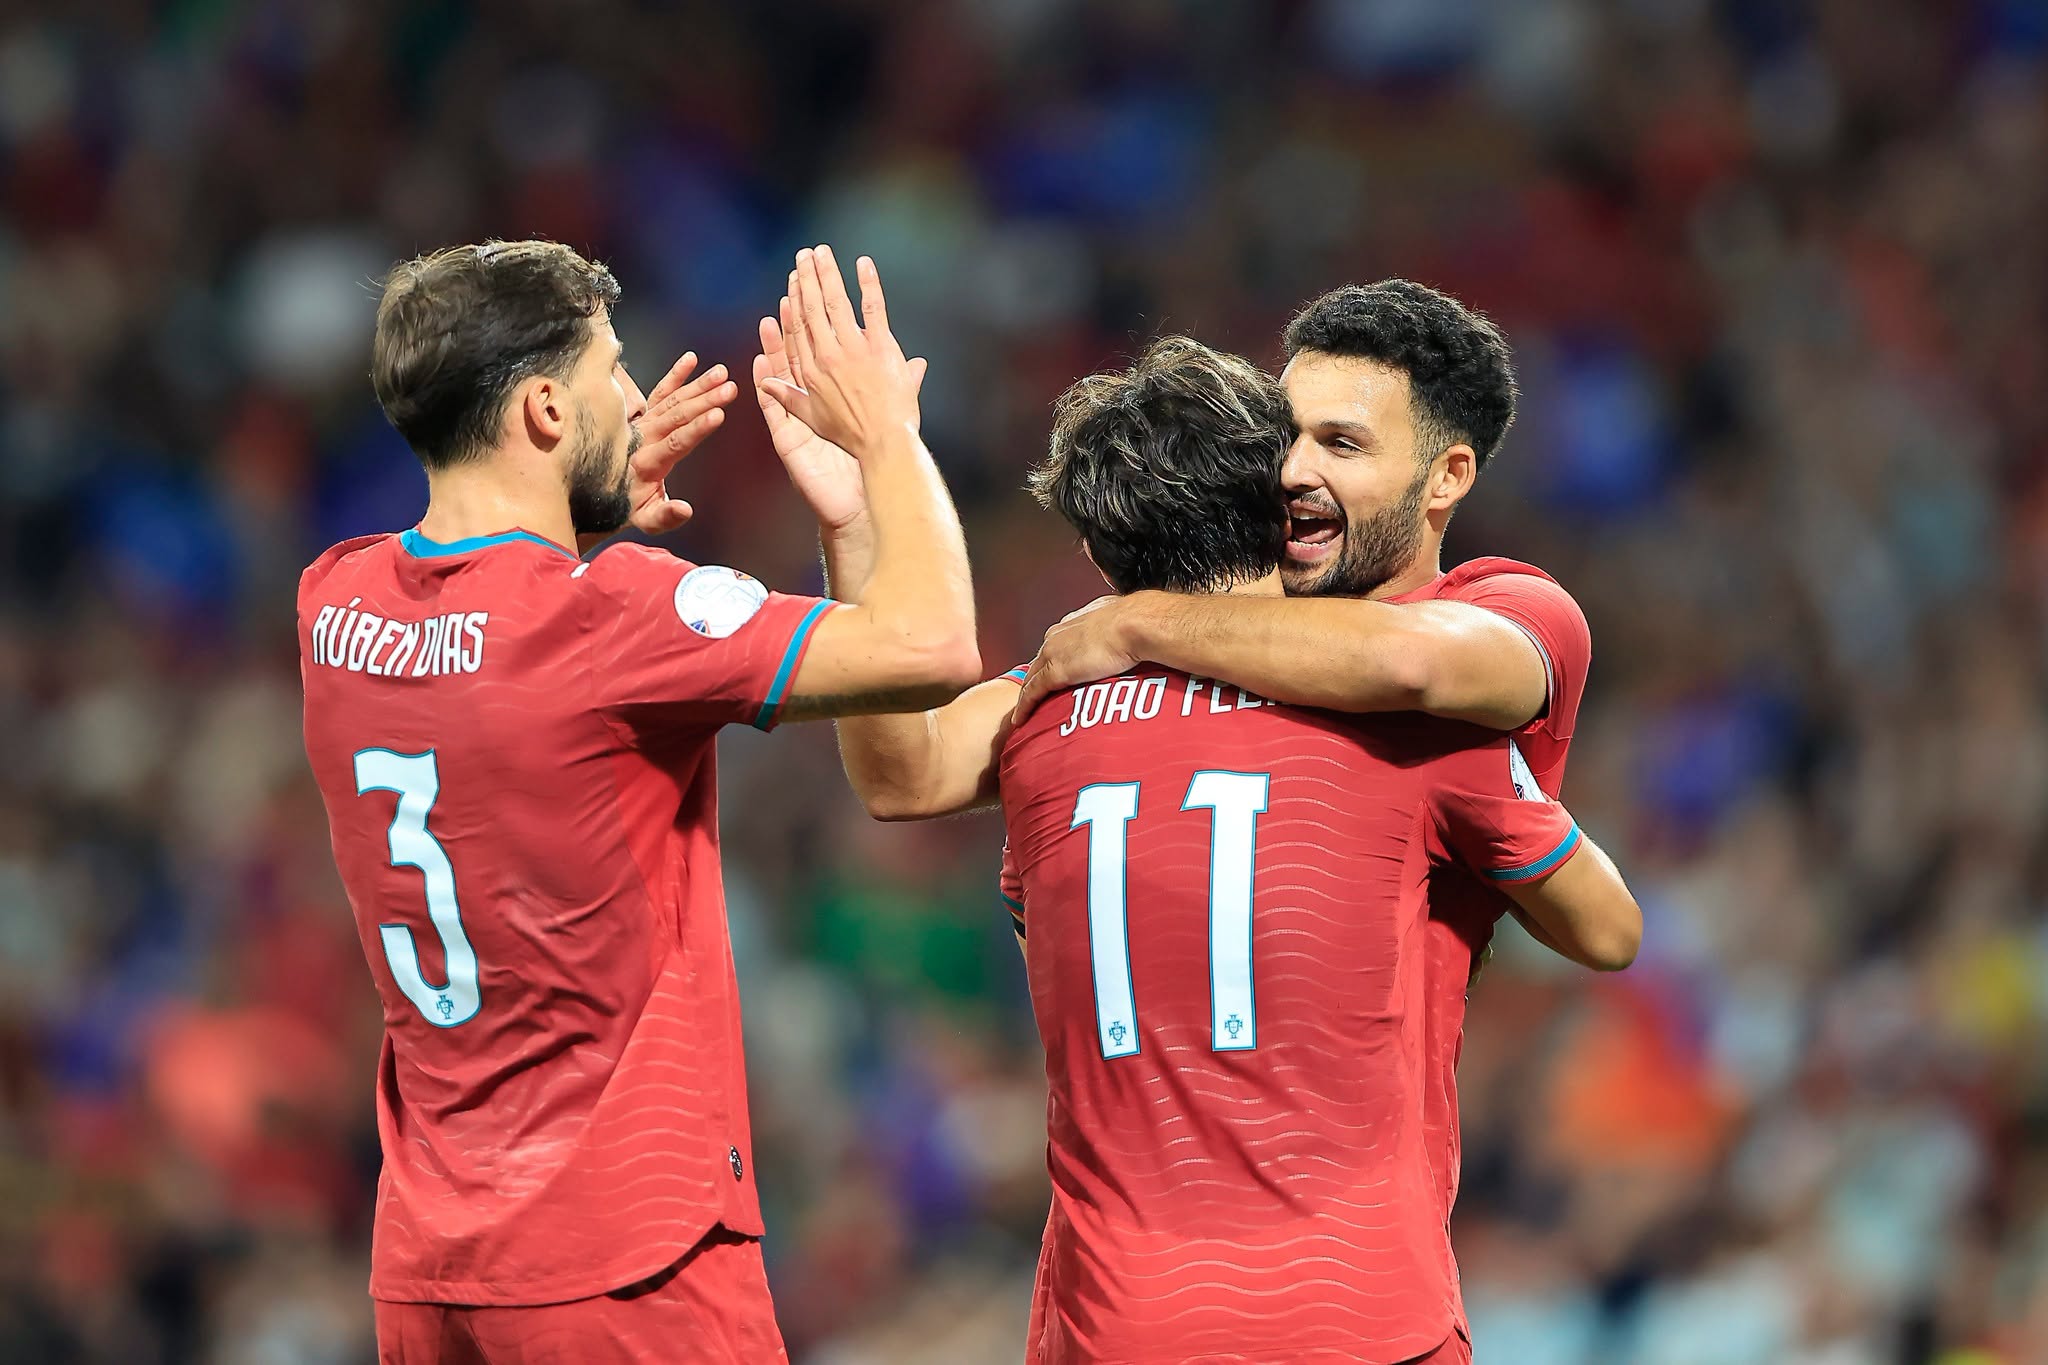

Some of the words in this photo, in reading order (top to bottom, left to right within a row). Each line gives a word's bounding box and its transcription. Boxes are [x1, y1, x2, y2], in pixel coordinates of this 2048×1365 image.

[313, 597, 420, 678] RÚBEN
[411, 612, 489, 677] DIAS
[1060, 676, 1167, 737] JOÃO
[353, 747, 482, 1028] 3
[1070, 770, 1271, 1061] 11
